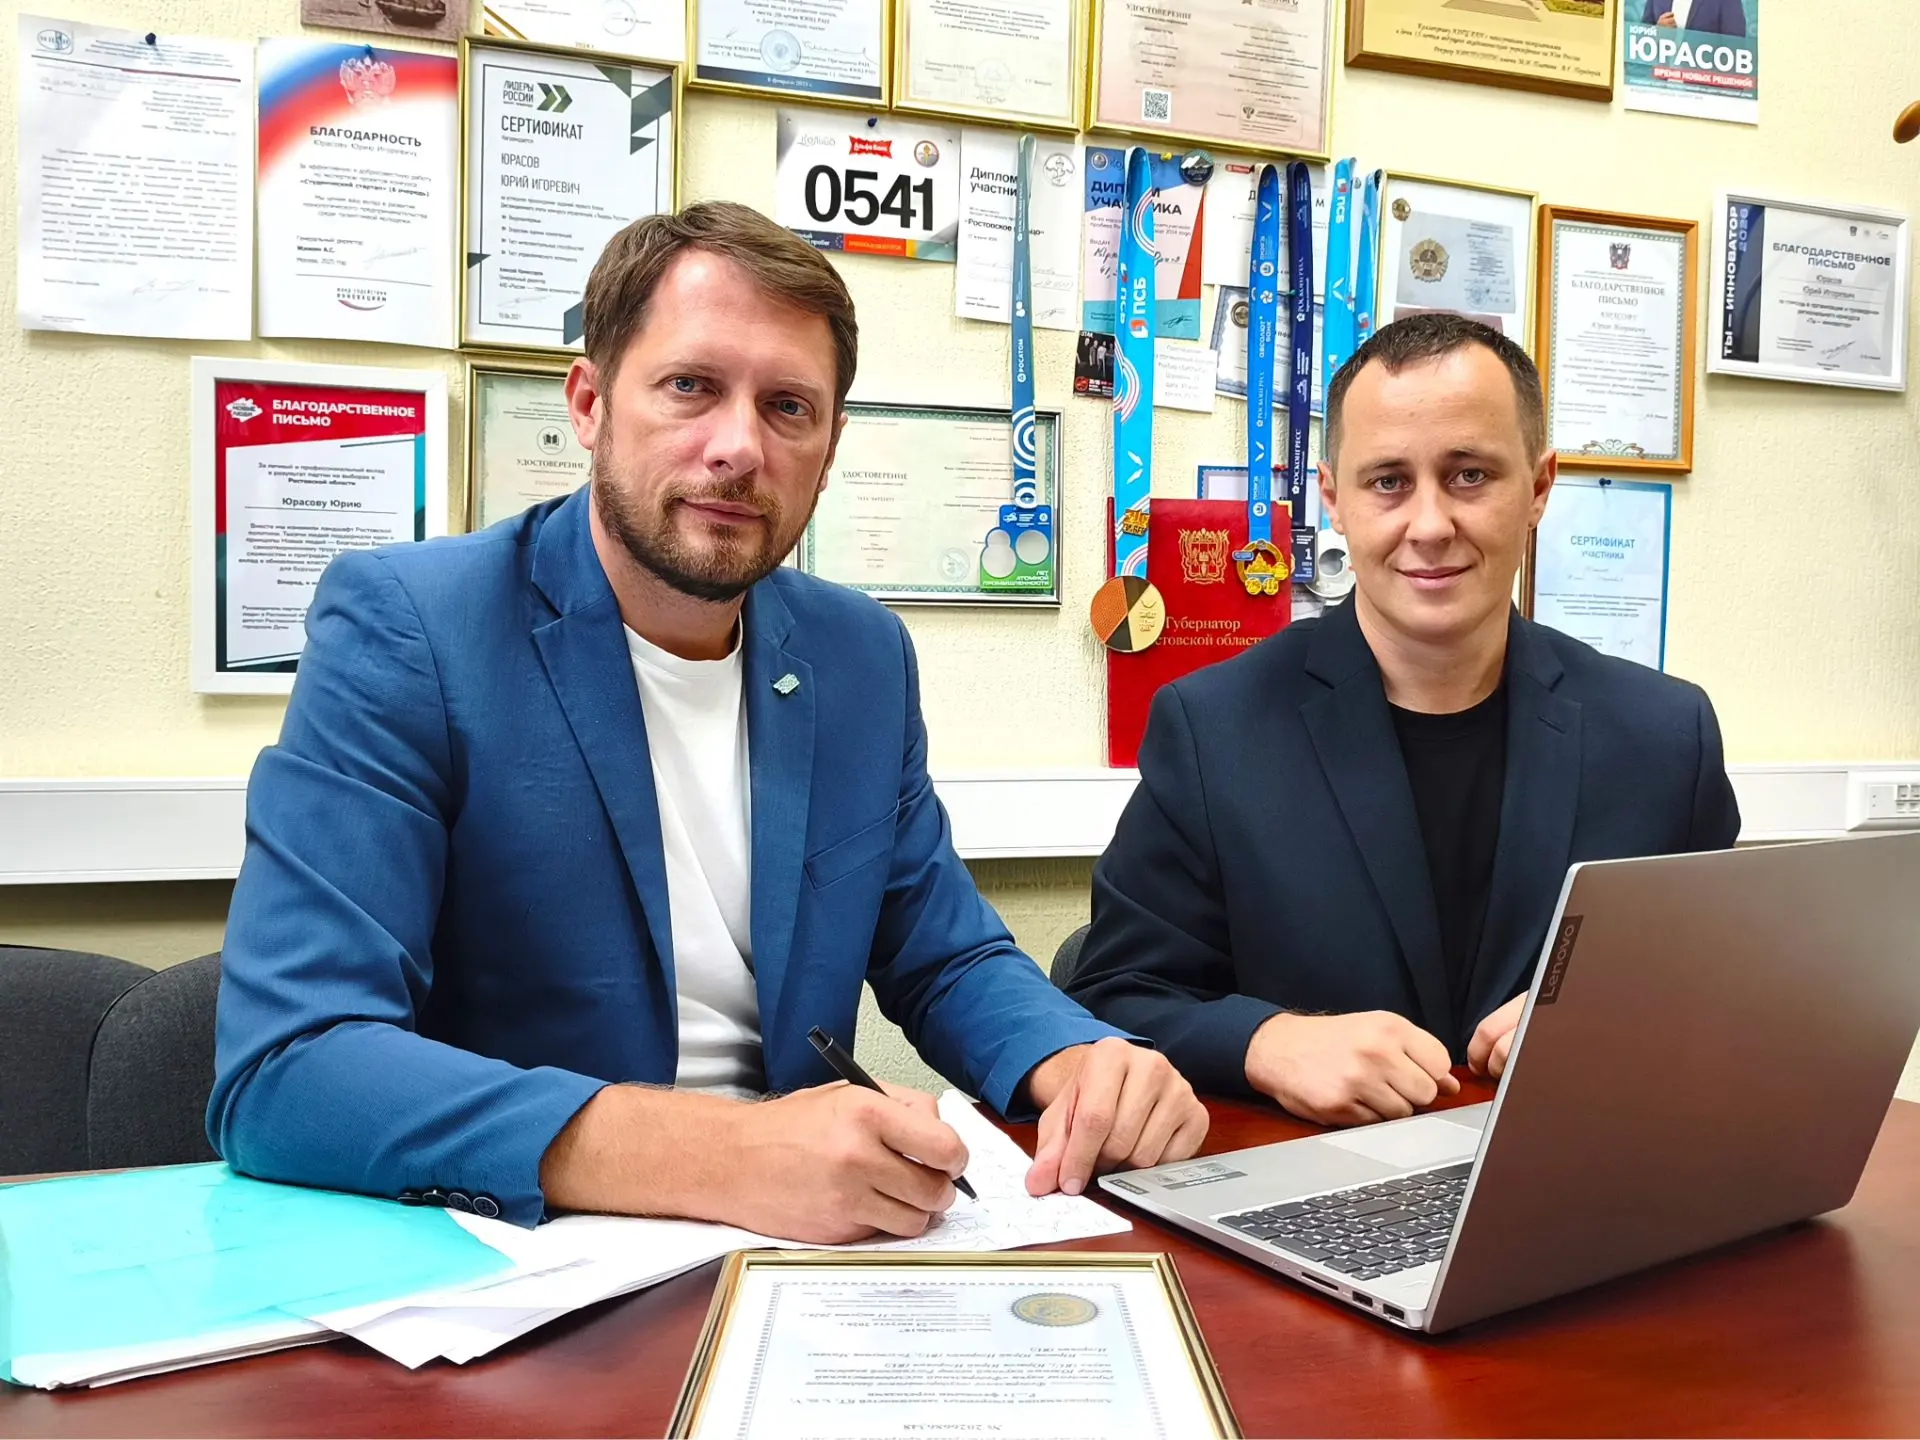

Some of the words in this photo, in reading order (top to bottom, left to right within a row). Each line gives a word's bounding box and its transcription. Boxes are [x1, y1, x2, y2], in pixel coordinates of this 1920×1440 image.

[1629, 25, 1657, 37] ЮРИЙ
[1628, 35, 1754, 75] ЮРАСОВ
[503, 80, 534, 92] ЛИДЕРЫ
[1653, 67, 1681, 79] ВРЕМЯ
[1682, 71, 1711, 83] НОВЫХ
[1712, 75, 1753, 88] РЕШЕНИЙ
[502, 90, 534, 103] РОССИИ
[310, 125, 422, 147] БЛАГОДАРНОСТЬ
[501, 115, 584, 140] СЕРТИФИКАТ
[501, 152, 540, 169] ЮРАСОВ
[970, 166, 1018, 184] Диплом
[500, 174, 529, 189] ЮРИЙ
[531, 178, 581, 195] ИГОРЕВИЧ
[970, 180, 1018, 197] участни
[805, 164, 934, 231] 0541
[1335, 195, 1346, 224] ПСБ
[1725, 205, 1738, 310] ИННОВАТОР
[1772, 242, 1891, 266] БЛАГОДАРСТВЕННОЕ
[1807, 257, 1856, 271] ПИСЬМО
[1133, 276, 1147, 315] ПСБ
[1571, 279, 1666, 296] БЛАГОДАРСТВЕННОЕ
[1598, 295, 1639, 307] ПИСЬМО
[1723, 330, 1733, 357] ТЫ
[1017, 338, 1025, 373] РОСАТОМ
[272, 399, 416, 418] БЛАГОДАРСТВЕННОЕ
[272, 413, 331, 427] ПИСЬМО
[516, 458, 584, 469] УДОСТОВЕРЕНИЕ
[1294, 428, 1302, 487] РОСКОНГРЕСС
[842, 471, 908, 480] УДОСТОВЕРЕНИЕ
[282, 497, 327, 509] Юрасову
[330, 498, 362, 509] Юрию
[1570, 535, 1636, 549] СЕРТИФИКАТ
[1582, 550, 1625, 560] УЧАСТНИКА
[1165, 616, 1241, 632] Губернатор
[1154, 633, 1213, 647] стовской
[1541, 923, 1575, 998] Lenovo
